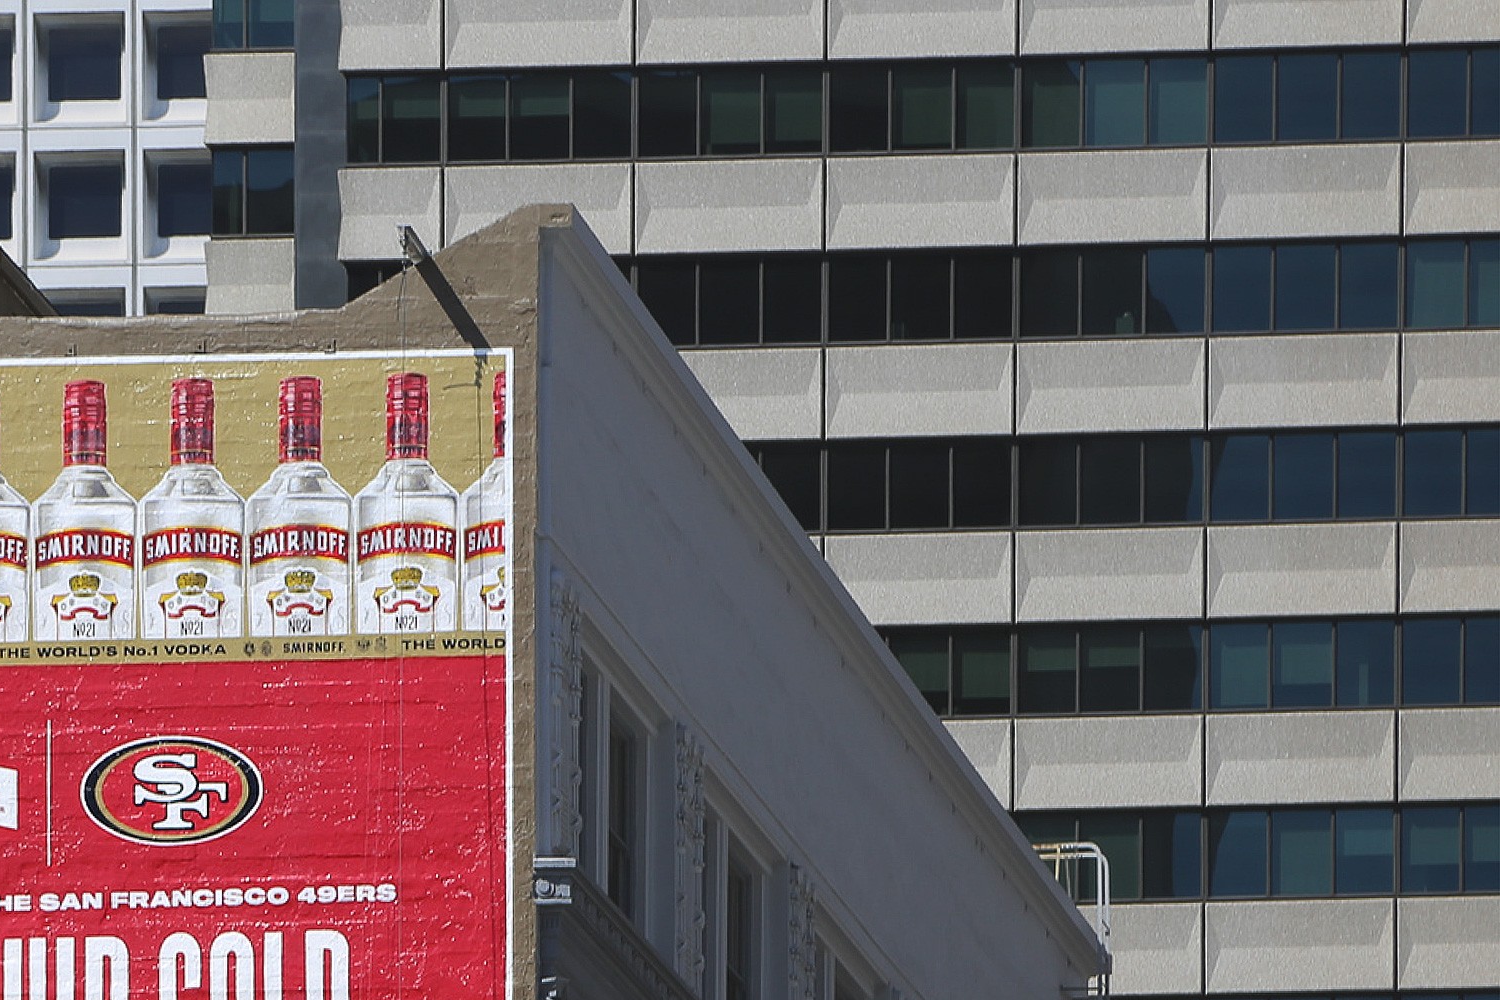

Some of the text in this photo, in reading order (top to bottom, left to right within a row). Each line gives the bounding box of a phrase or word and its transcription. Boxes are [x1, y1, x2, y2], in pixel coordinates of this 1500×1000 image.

[37, 646, 118, 658] WORLD'S
[124, 645, 159, 657] No.1
[164, 643, 227, 656] VODKA
[402, 639, 436, 650] THE
[442, 638, 506, 649] WORLD
[134, 753, 228, 831] SF
[39, 892, 103, 911] SAN
[110, 886, 290, 910] FRANCISCO
[297, 883, 398, 904] 49ERS
